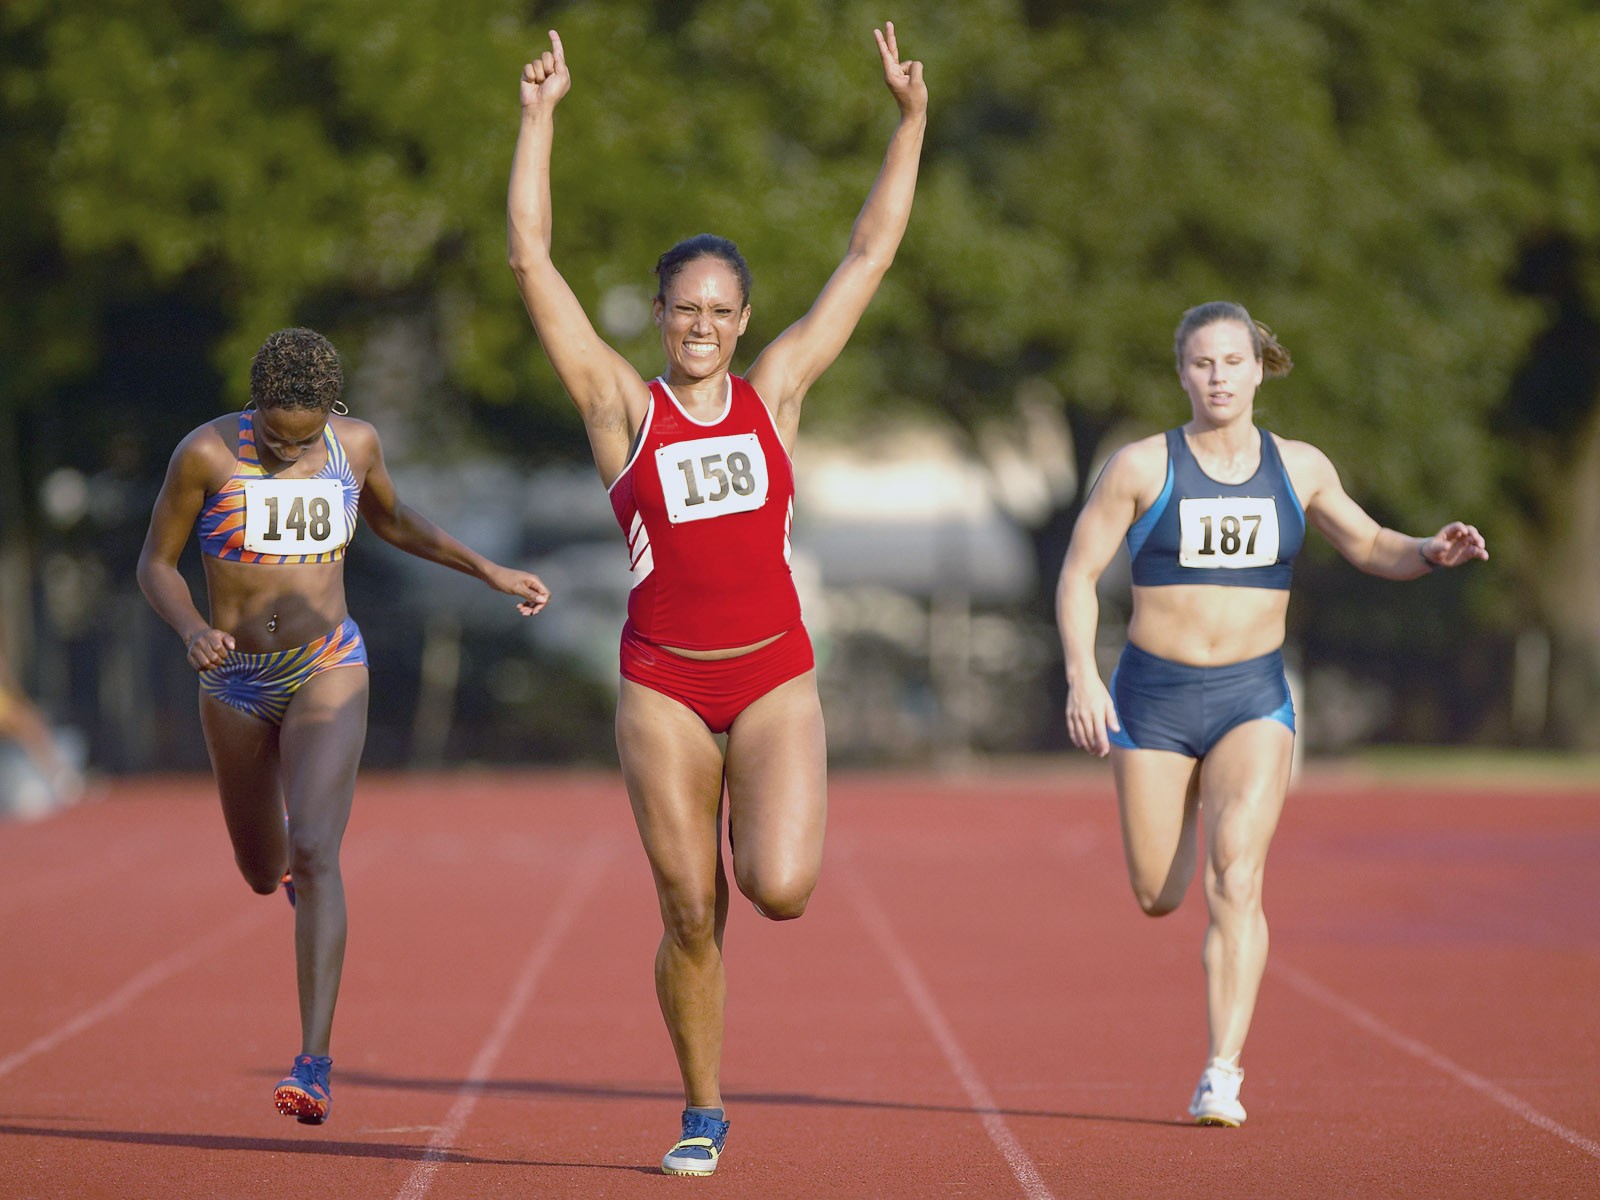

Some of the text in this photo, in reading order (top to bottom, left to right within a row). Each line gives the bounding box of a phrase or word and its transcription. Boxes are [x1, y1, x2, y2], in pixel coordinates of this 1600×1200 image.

[677, 451, 756, 507] 158
[263, 496, 331, 541] 148
[1198, 515, 1262, 555] 187
